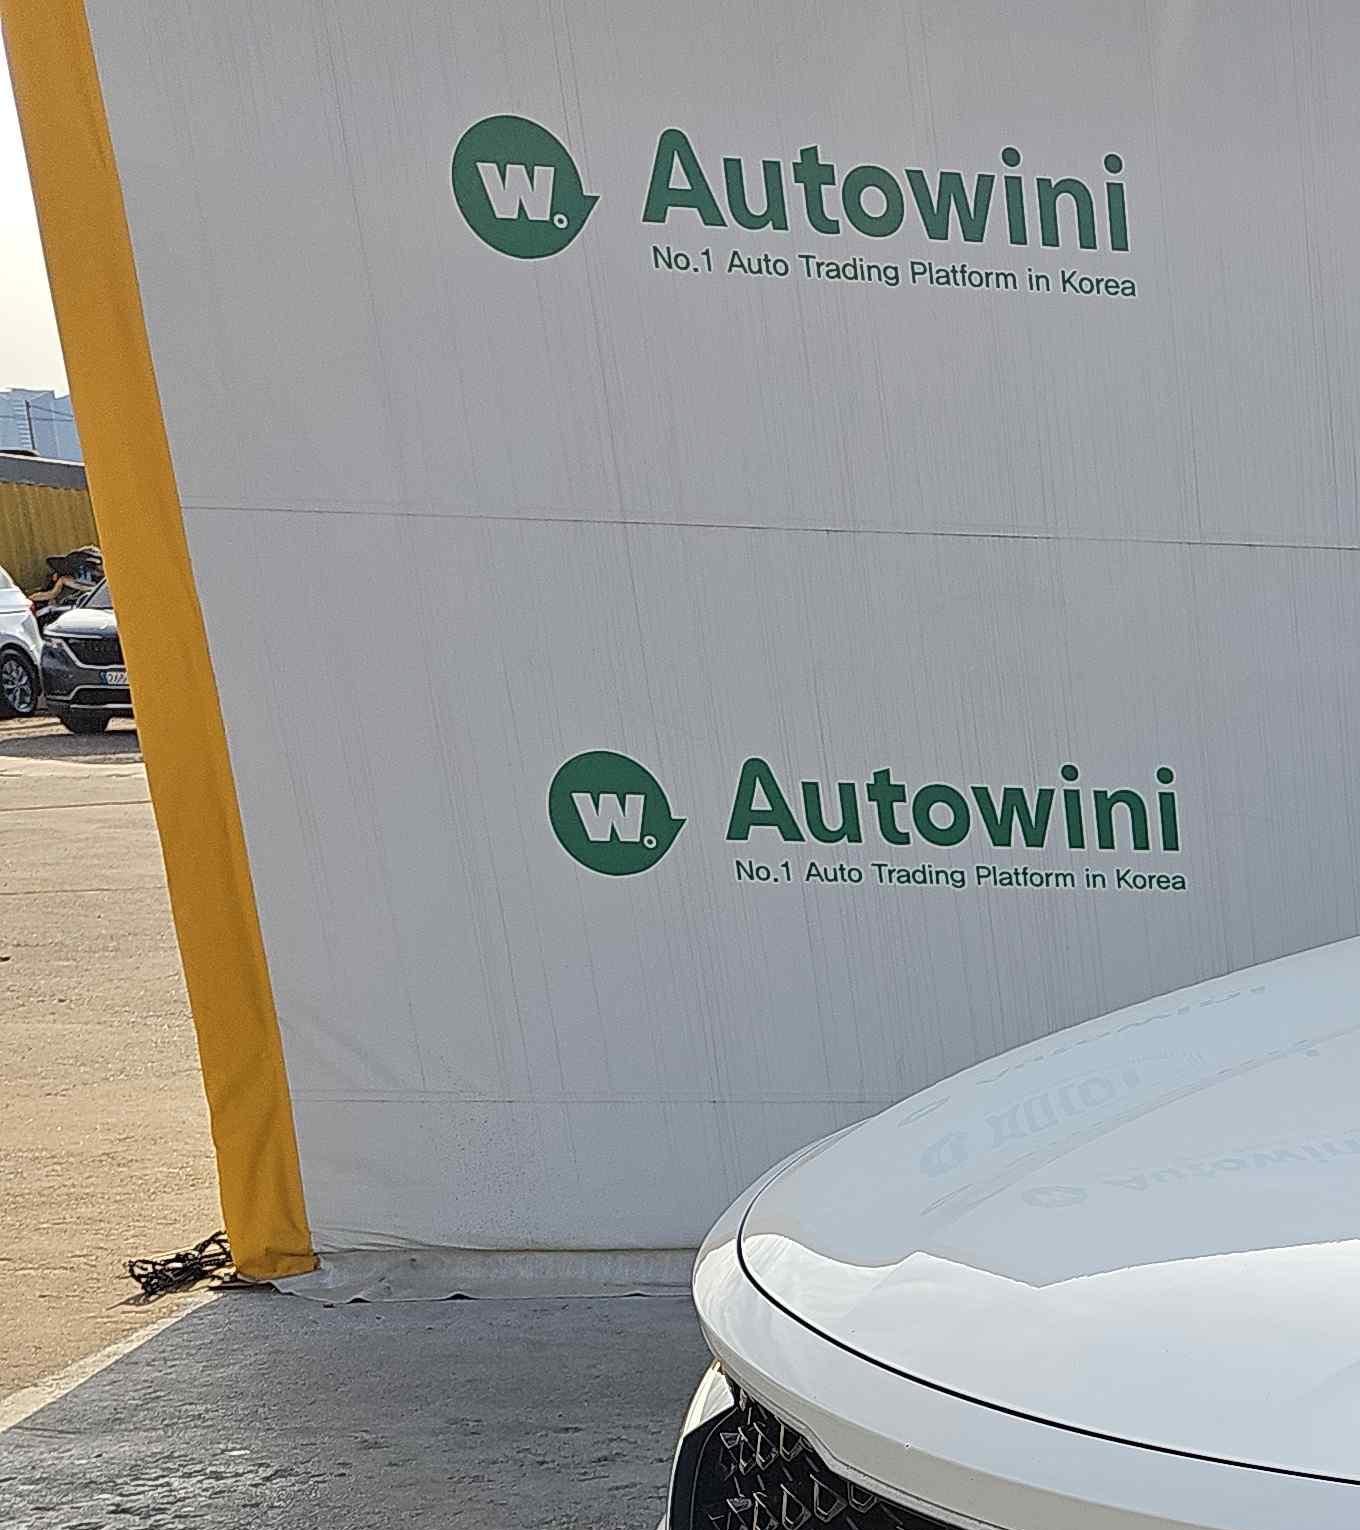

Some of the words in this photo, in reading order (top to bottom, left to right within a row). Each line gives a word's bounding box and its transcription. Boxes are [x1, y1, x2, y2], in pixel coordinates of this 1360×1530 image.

[641, 128, 1129, 252] Autowini
[652, 245, 712, 273] No.1
[727, 250, 789, 277] Auto
[797, 254, 900, 287] Trading
[910, 260, 1018, 290] Platform
[1028, 267, 1051, 292] in
[1060, 269, 1137, 297] Korea
[725, 757, 1180, 852] Autowini
[735, 859, 791, 882] No.1
[805, 861, 863, 884] Auto
[870, 862, 966, 889] Trading
[975, 865, 1076, 888] Platform
[1085, 868, 1106, 889] in
[1115, 868, 1187, 891] Korea
